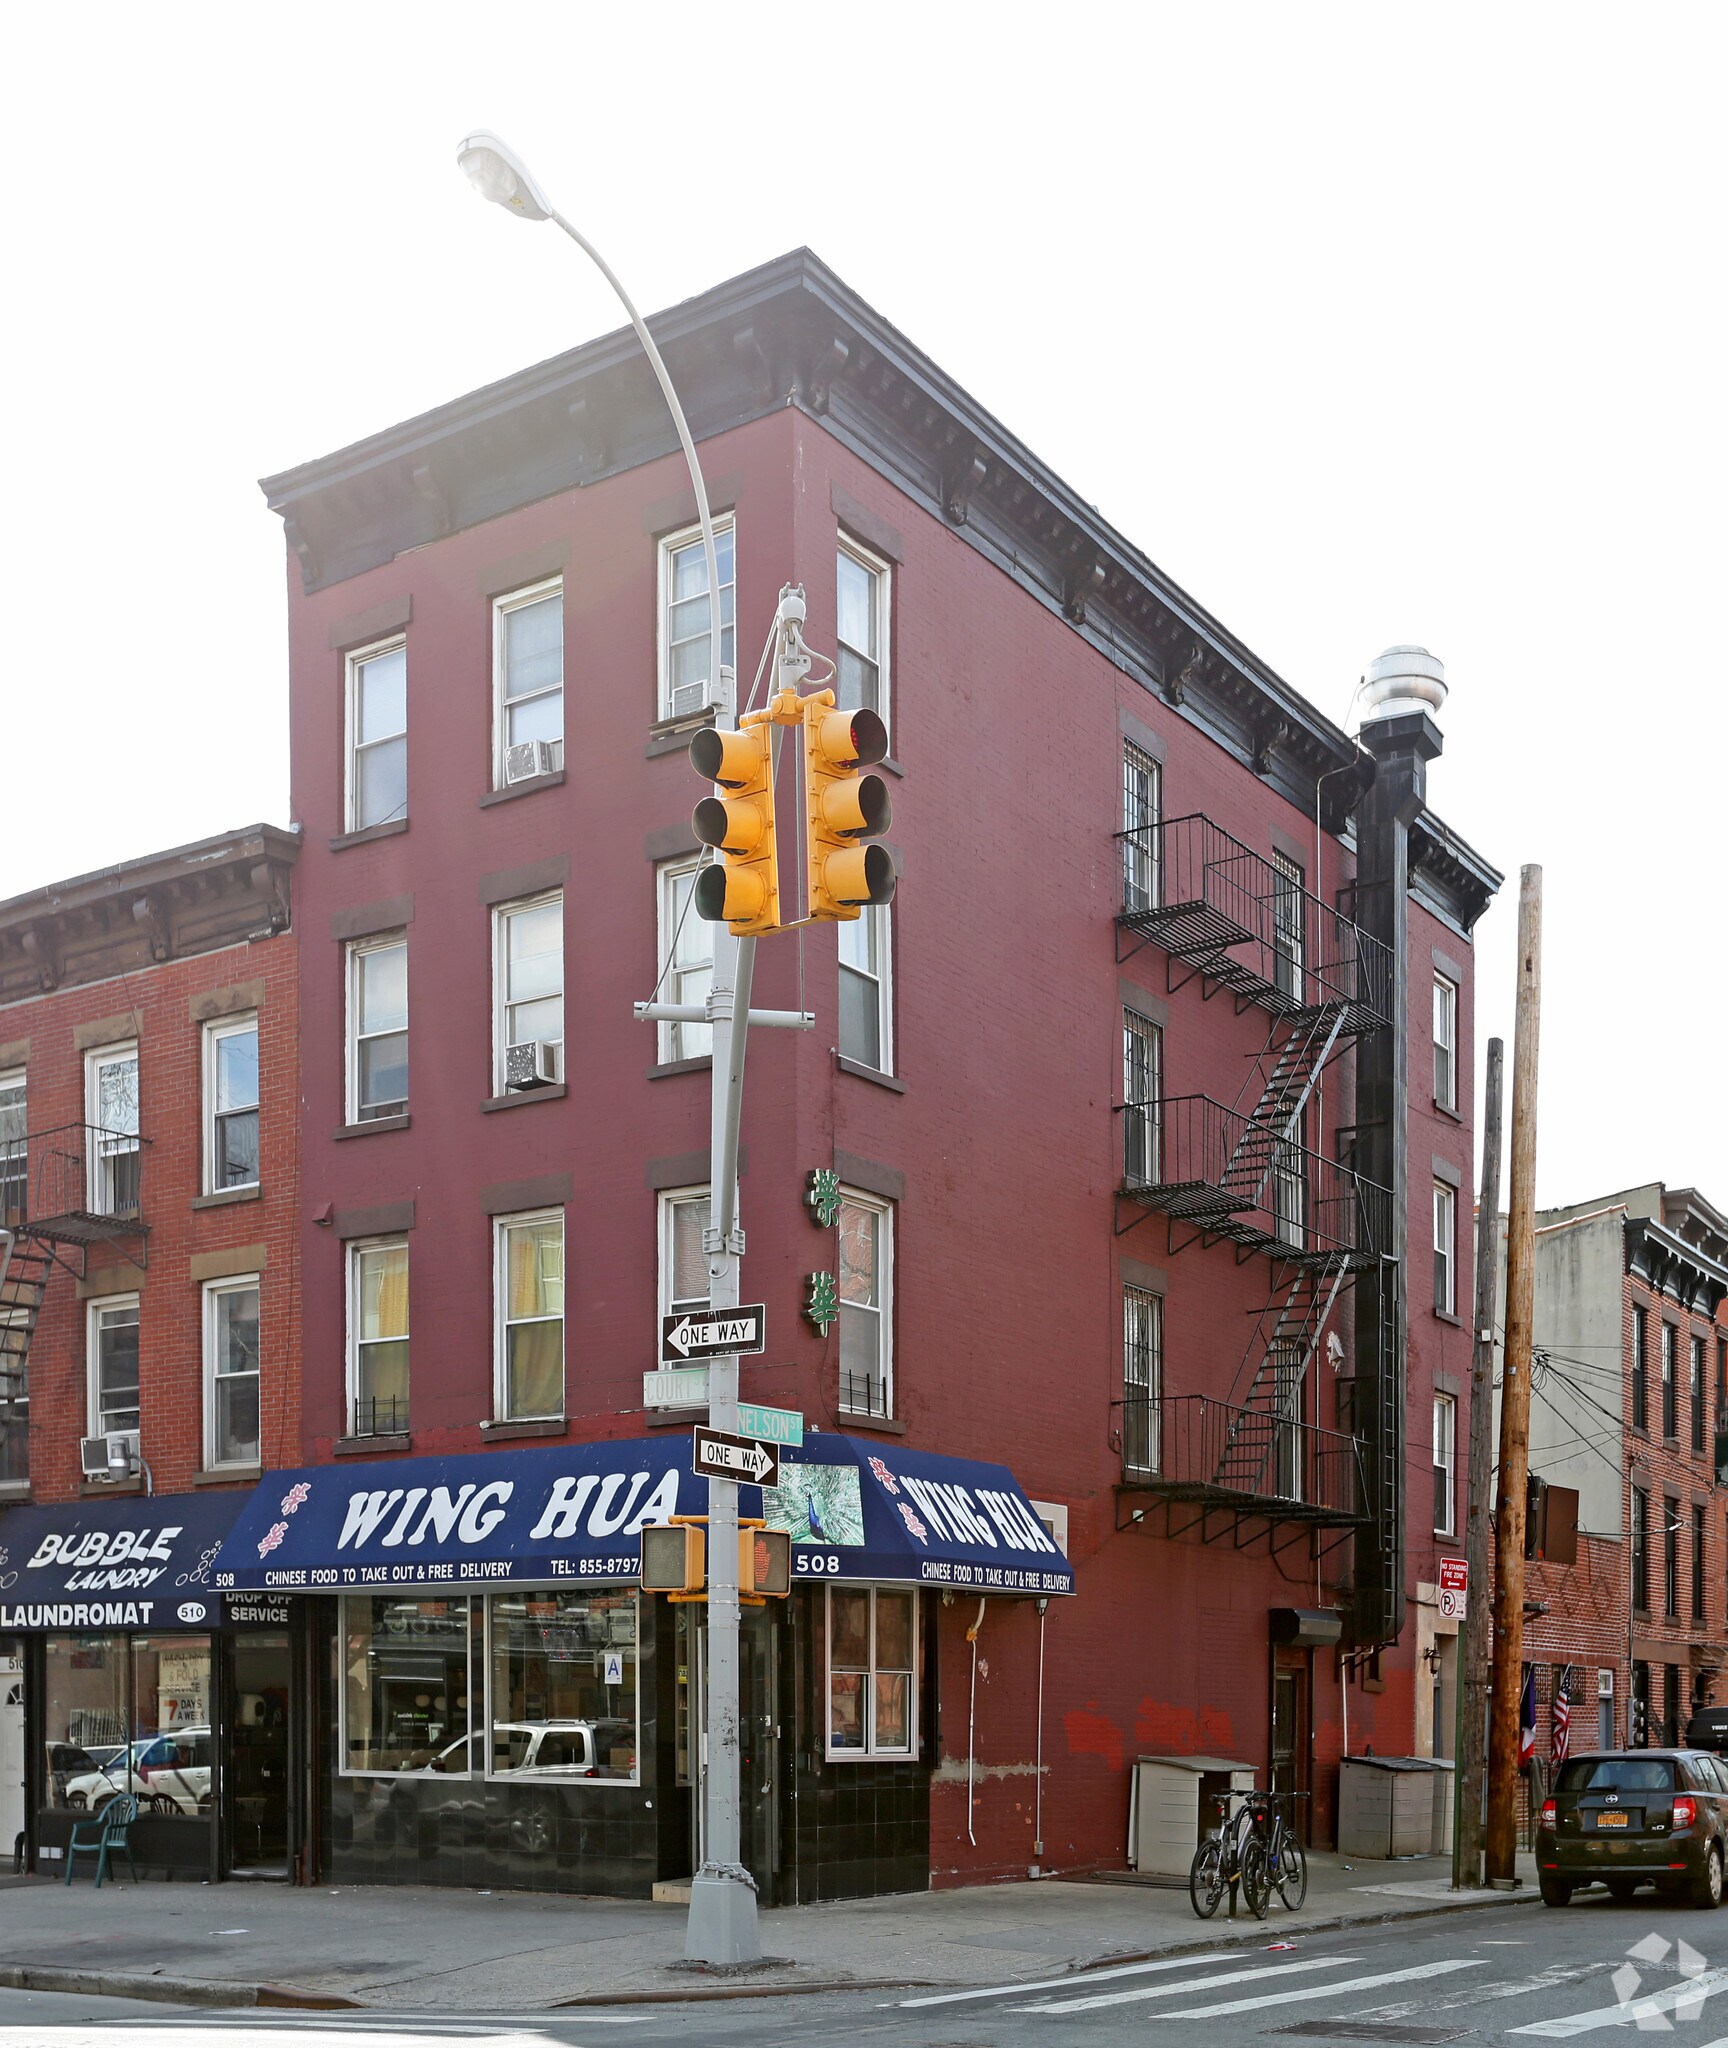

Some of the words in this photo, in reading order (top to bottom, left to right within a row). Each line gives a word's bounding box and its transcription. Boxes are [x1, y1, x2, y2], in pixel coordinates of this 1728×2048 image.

[680, 1326, 709, 1345] ONE
[718, 1321, 749, 1341] WAY
[648, 1374, 691, 1401] COURT
[737, 1407, 789, 1440] NELSON
[790, 1415, 800, 1430] ST
[707, 1444, 731, 1465] ONE
[742, 1451, 766, 1471] WAY
[337, 1481, 514, 1550] WING
[529, 1468, 679, 1540] HUA
[899, 1475, 998, 1548] WING
[975, 1488, 1056, 1553] HUA
[26, 1526, 183, 1568] BUBBLE
[265, 1570, 306, 1586] CHINESE
[311, 1568, 338, 1584] FOOD
[342, 1568, 356, 1583] TO
[360, 1567, 388, 1582] TAKE
[392, 1565, 414, 1581] OUT
[416, 1565, 425, 1580] &
[428, 1564, 454, 1579] FREE
[460, 1561, 513, 1578] DELIVERY
[551, 1559, 576, 1575] TEL:
[796, 1554, 839, 1573] 508
[1448, 1563, 1467, 1572] STANDING
[64, 1566, 168, 1592] LAUNDRY
[215, 1572, 235, 1587] 508
[922, 1561, 951, 1580] CHINESE
[953, 1564, 972, 1582] FOOD
[974, 1567, 983, 1583] TO
[985, 1568, 1002, 1585] TAKE
[1004, 1570, 1018, 1586] OUT
[1019, 1572, 1025, 1587] &
[1025, 1572, 1040, 1588] FREE
[1042, 1573, 1071, 1591] DELIVERY
[225, 1592, 263, 1604] DROP
[0, 1601, 154, 1627] LAUNDROMAT
[181, 1607, 204, 1618] 510
[230, 1606, 288, 1623] SERVICE
[176, 1668, 199, 1681] FOLD
[608, 1658, 619, 1676] A
[164, 1700, 178, 1721] 7
[181, 1699, 202, 1710] DAYS
[177, 1711, 184, 1721] A
[184, 1711, 205, 1721] WEEK
